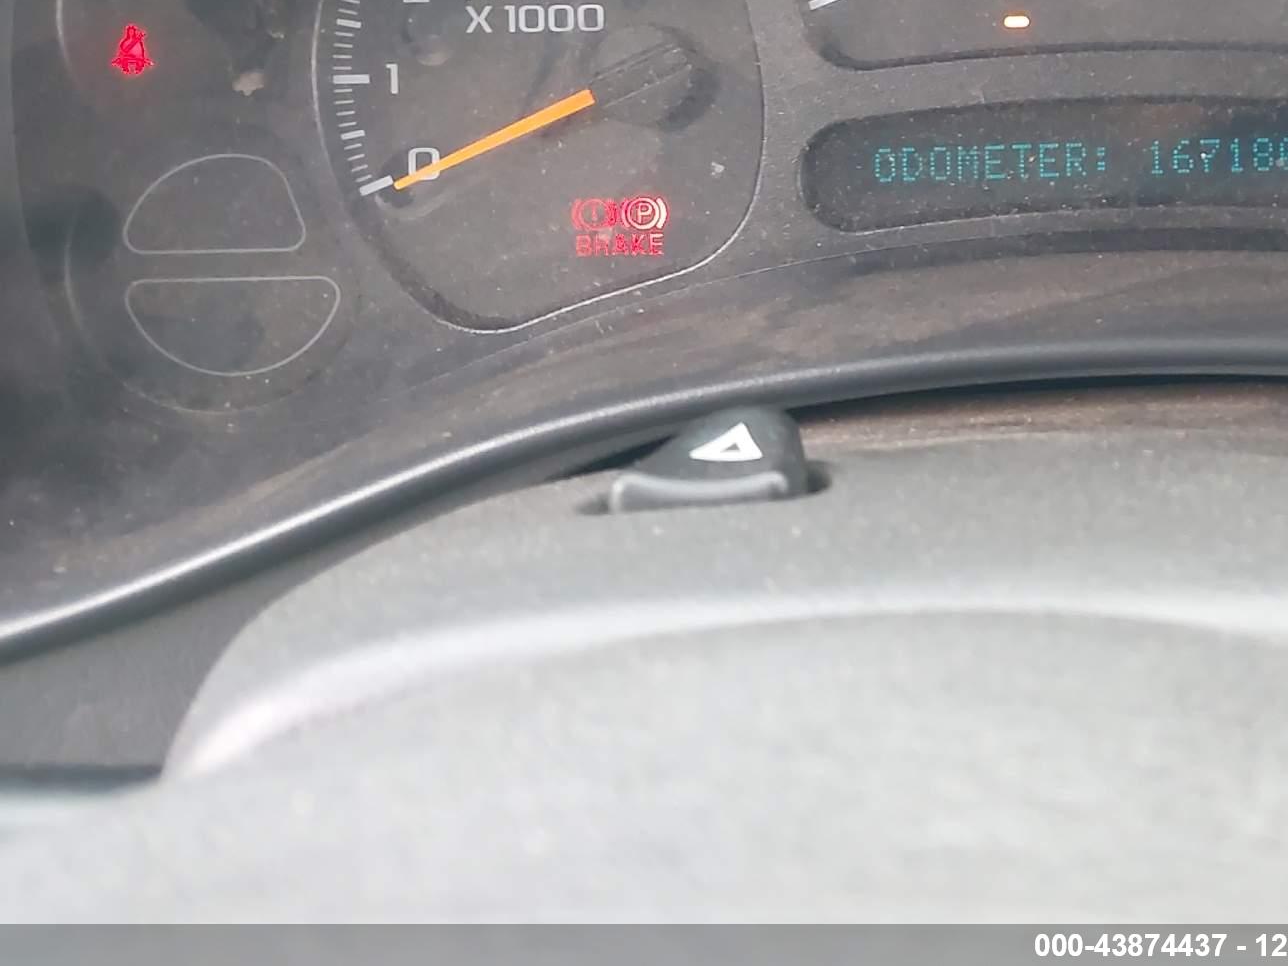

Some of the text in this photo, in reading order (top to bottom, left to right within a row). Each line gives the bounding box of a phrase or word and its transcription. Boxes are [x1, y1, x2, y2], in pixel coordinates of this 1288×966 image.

[465, 4, 605, 34] X 1000
[386, 63, 398, 95] 1
[408, 147, 441, 180] 0
[873, 142, 1107, 183] ODOMETER:
[575, 233, 665, 256] BRAKE
